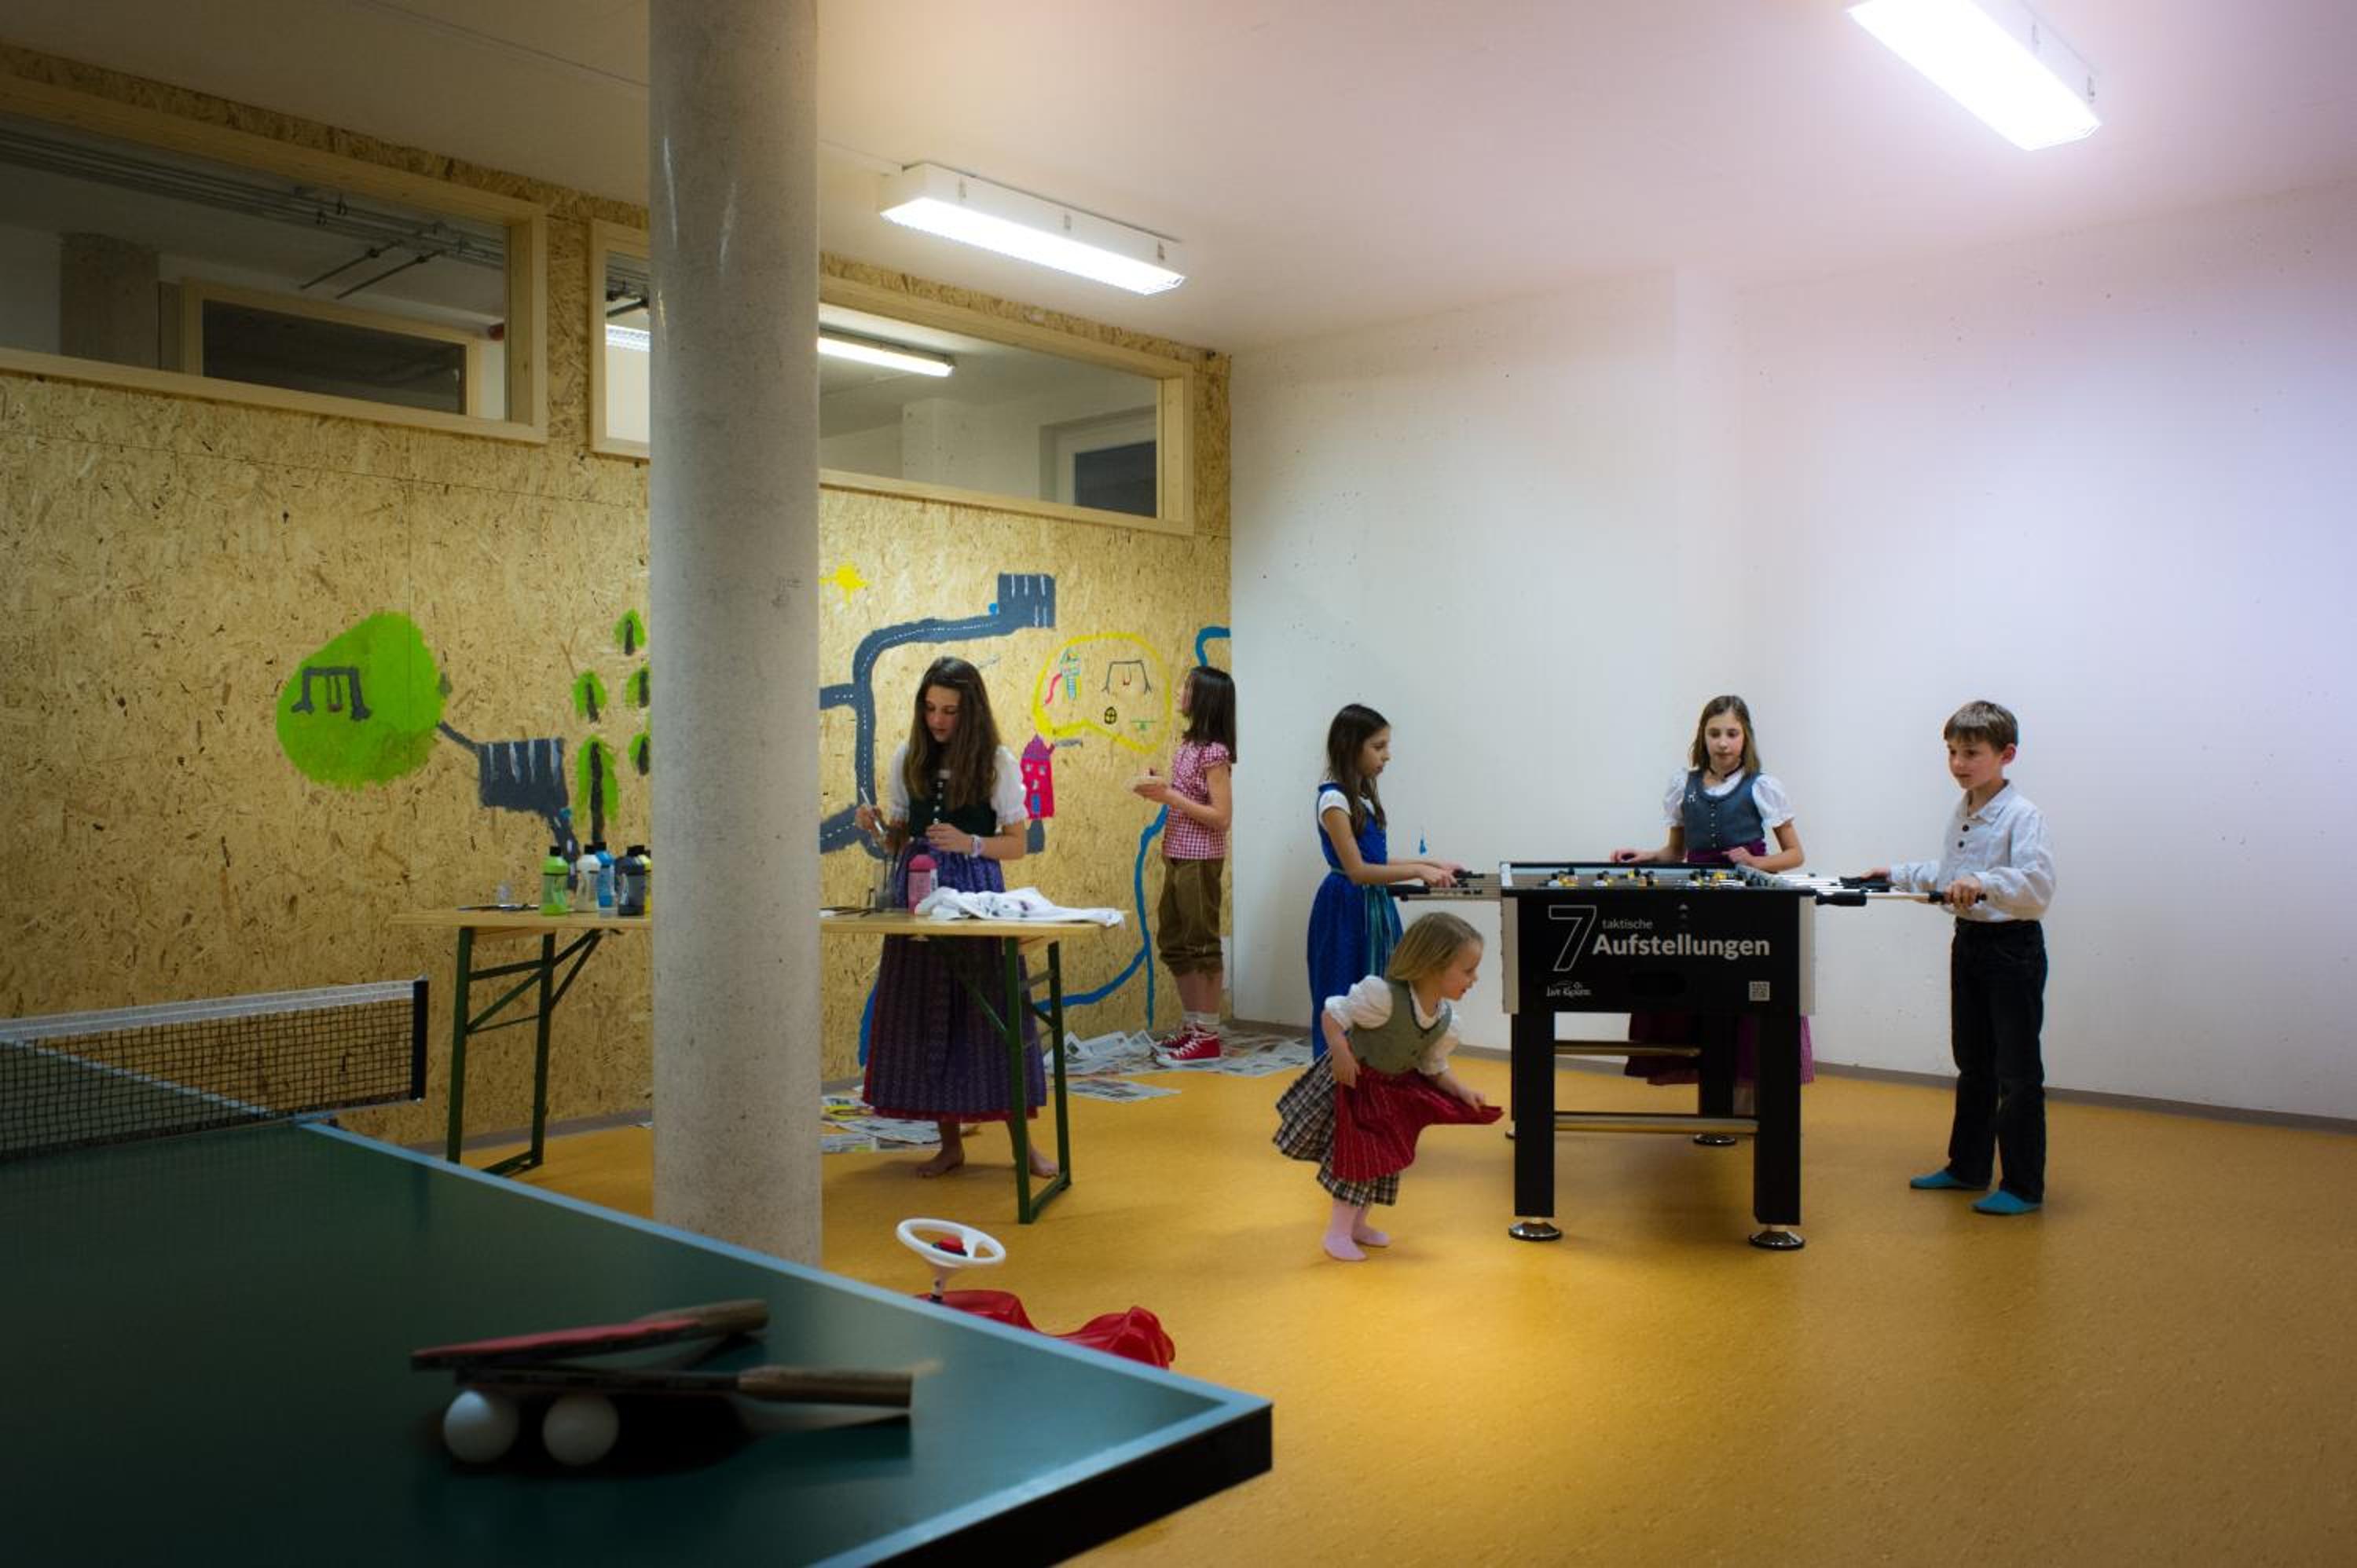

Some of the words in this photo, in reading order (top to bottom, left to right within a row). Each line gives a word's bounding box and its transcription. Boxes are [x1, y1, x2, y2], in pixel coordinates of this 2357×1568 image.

[1602, 918, 1653, 929] taktische
[1549, 904, 1597, 972] 7
[1592, 933, 1771, 960] Aufstellungen
